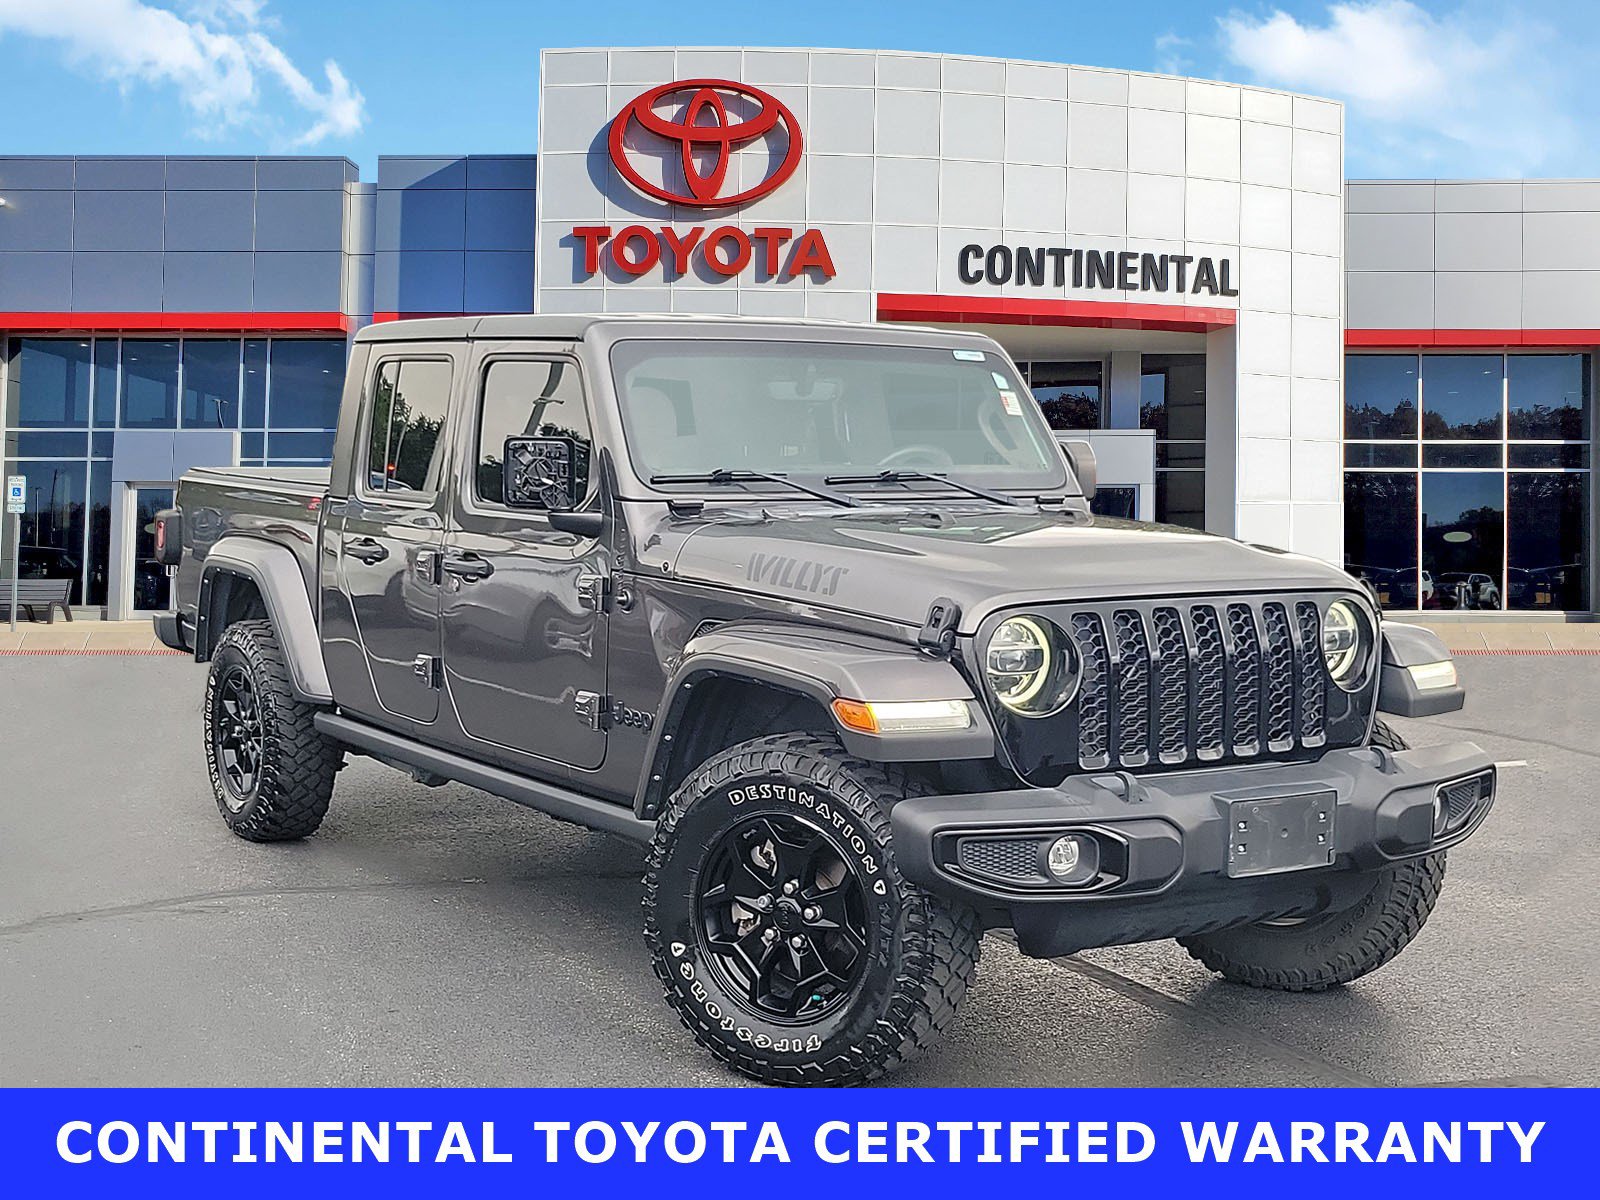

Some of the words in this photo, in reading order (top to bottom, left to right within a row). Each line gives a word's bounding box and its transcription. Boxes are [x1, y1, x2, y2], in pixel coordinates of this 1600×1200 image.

[573, 226, 837, 278] TOYOTA
[958, 244, 1239, 298] CONTINENTAL
[746, 551, 849, 597] WILLYS
[612, 699, 653, 734] Jeep
[727, 783, 877, 876] DESTINATION
